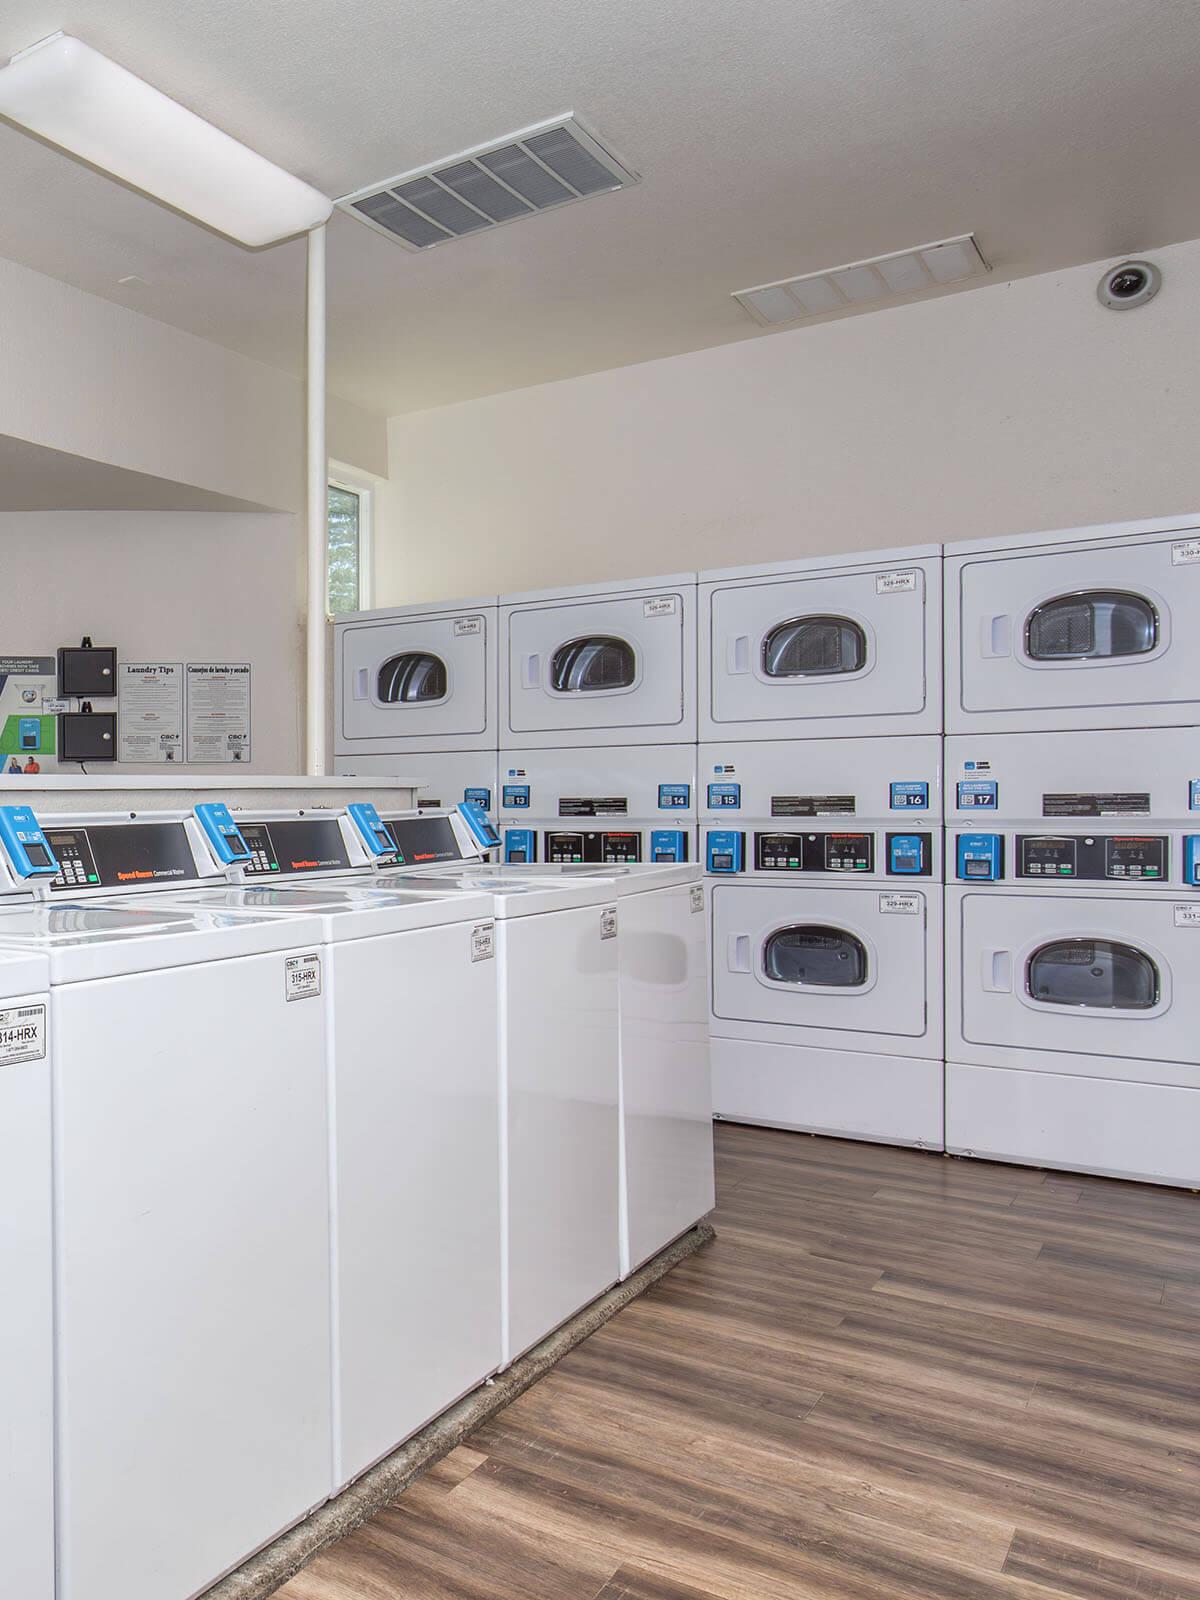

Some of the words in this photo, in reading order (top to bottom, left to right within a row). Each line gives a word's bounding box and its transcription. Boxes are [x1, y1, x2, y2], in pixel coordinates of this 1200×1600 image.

[127, 666, 157, 675] Laundry
[158, 666, 174, 675] Tips
[515, 796, 526, 805] 13
[673, 796, 686, 805] 14
[723, 796, 736, 805] 15
[909, 795, 922, 805] 16
[977, 795, 991, 804] 17
[117, 871, 136, 880] Speed
[135, 870, 153, 878] Queen
